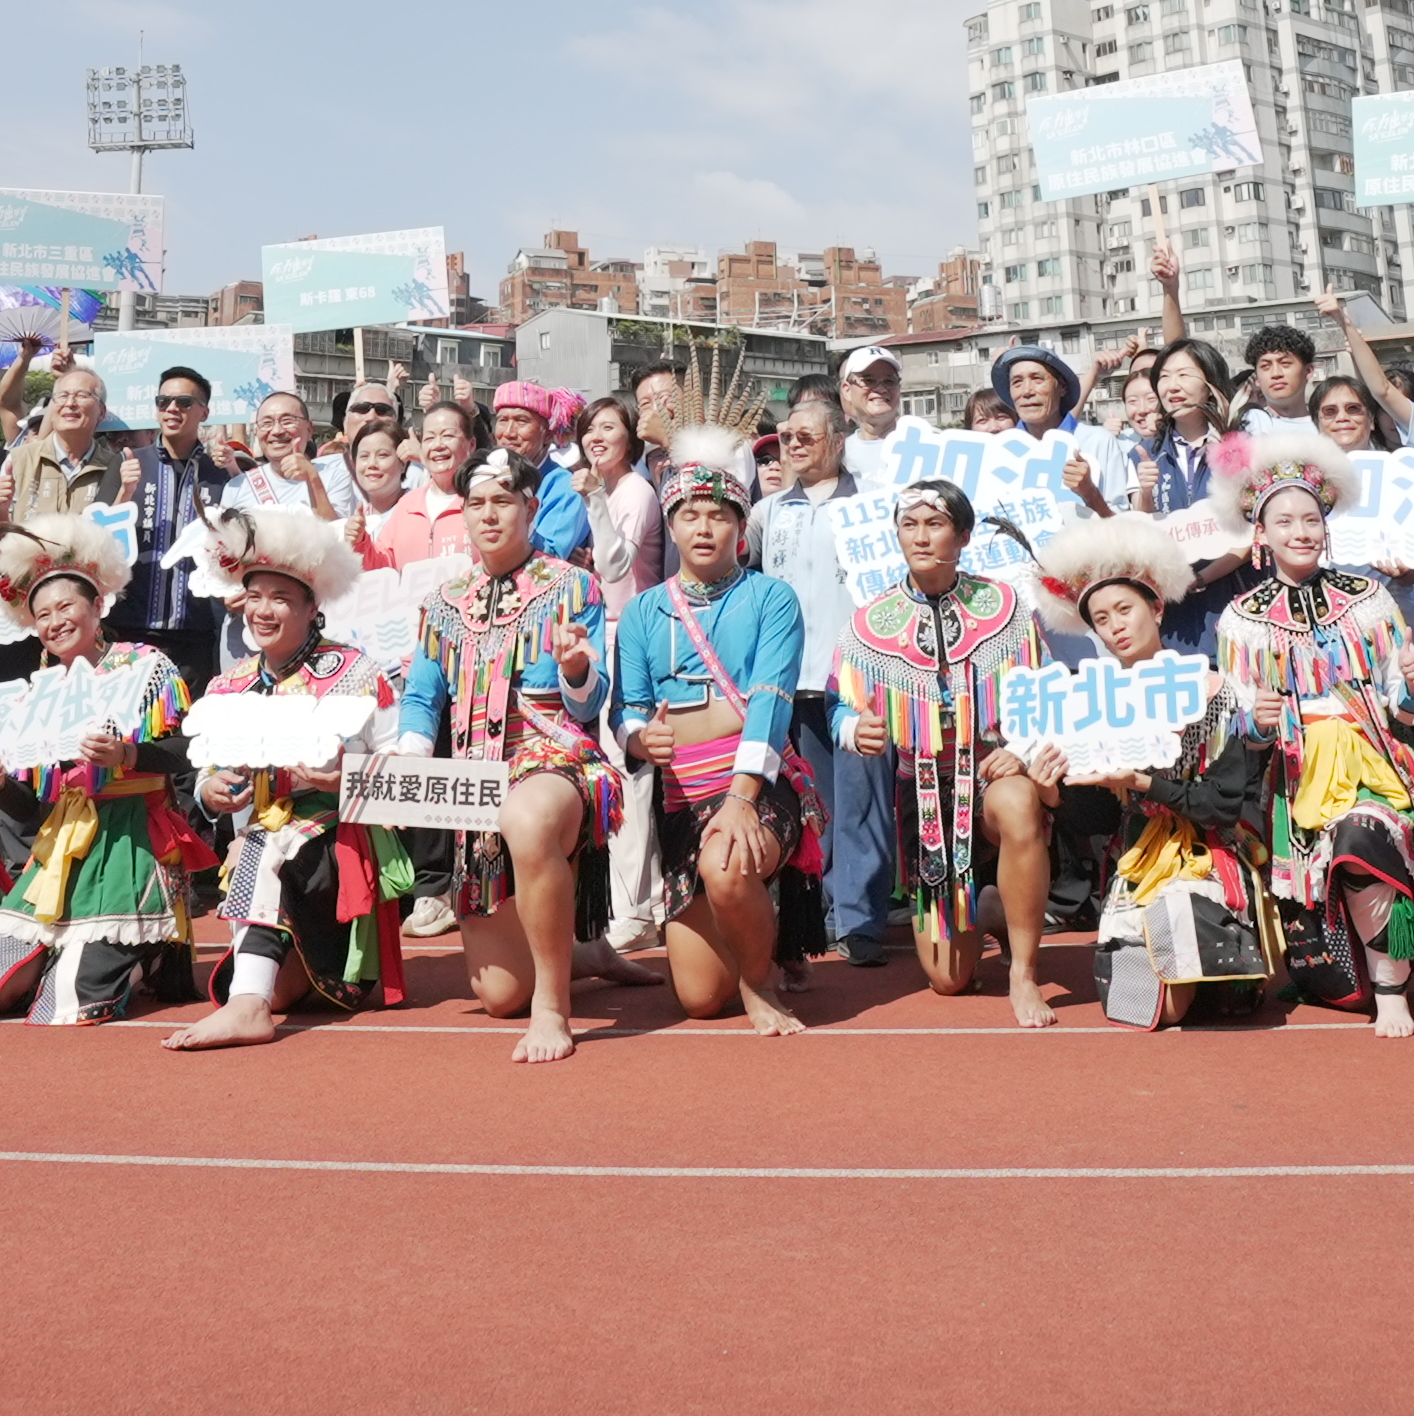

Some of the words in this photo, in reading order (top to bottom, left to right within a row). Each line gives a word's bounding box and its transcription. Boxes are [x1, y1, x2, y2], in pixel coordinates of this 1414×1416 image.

[1070, 131, 1178, 166] 新北市林口區
[1047, 147, 1207, 192] 原住民族發展協進會
[1, 242, 94, 263] 新北市三重區
[143, 482, 157, 544] 新北市議員
[1168, 518, 1220, 543] 化傳承
[1006, 657, 1202, 738] 新北市
[346, 771, 503, 808] 我就愛原住民
